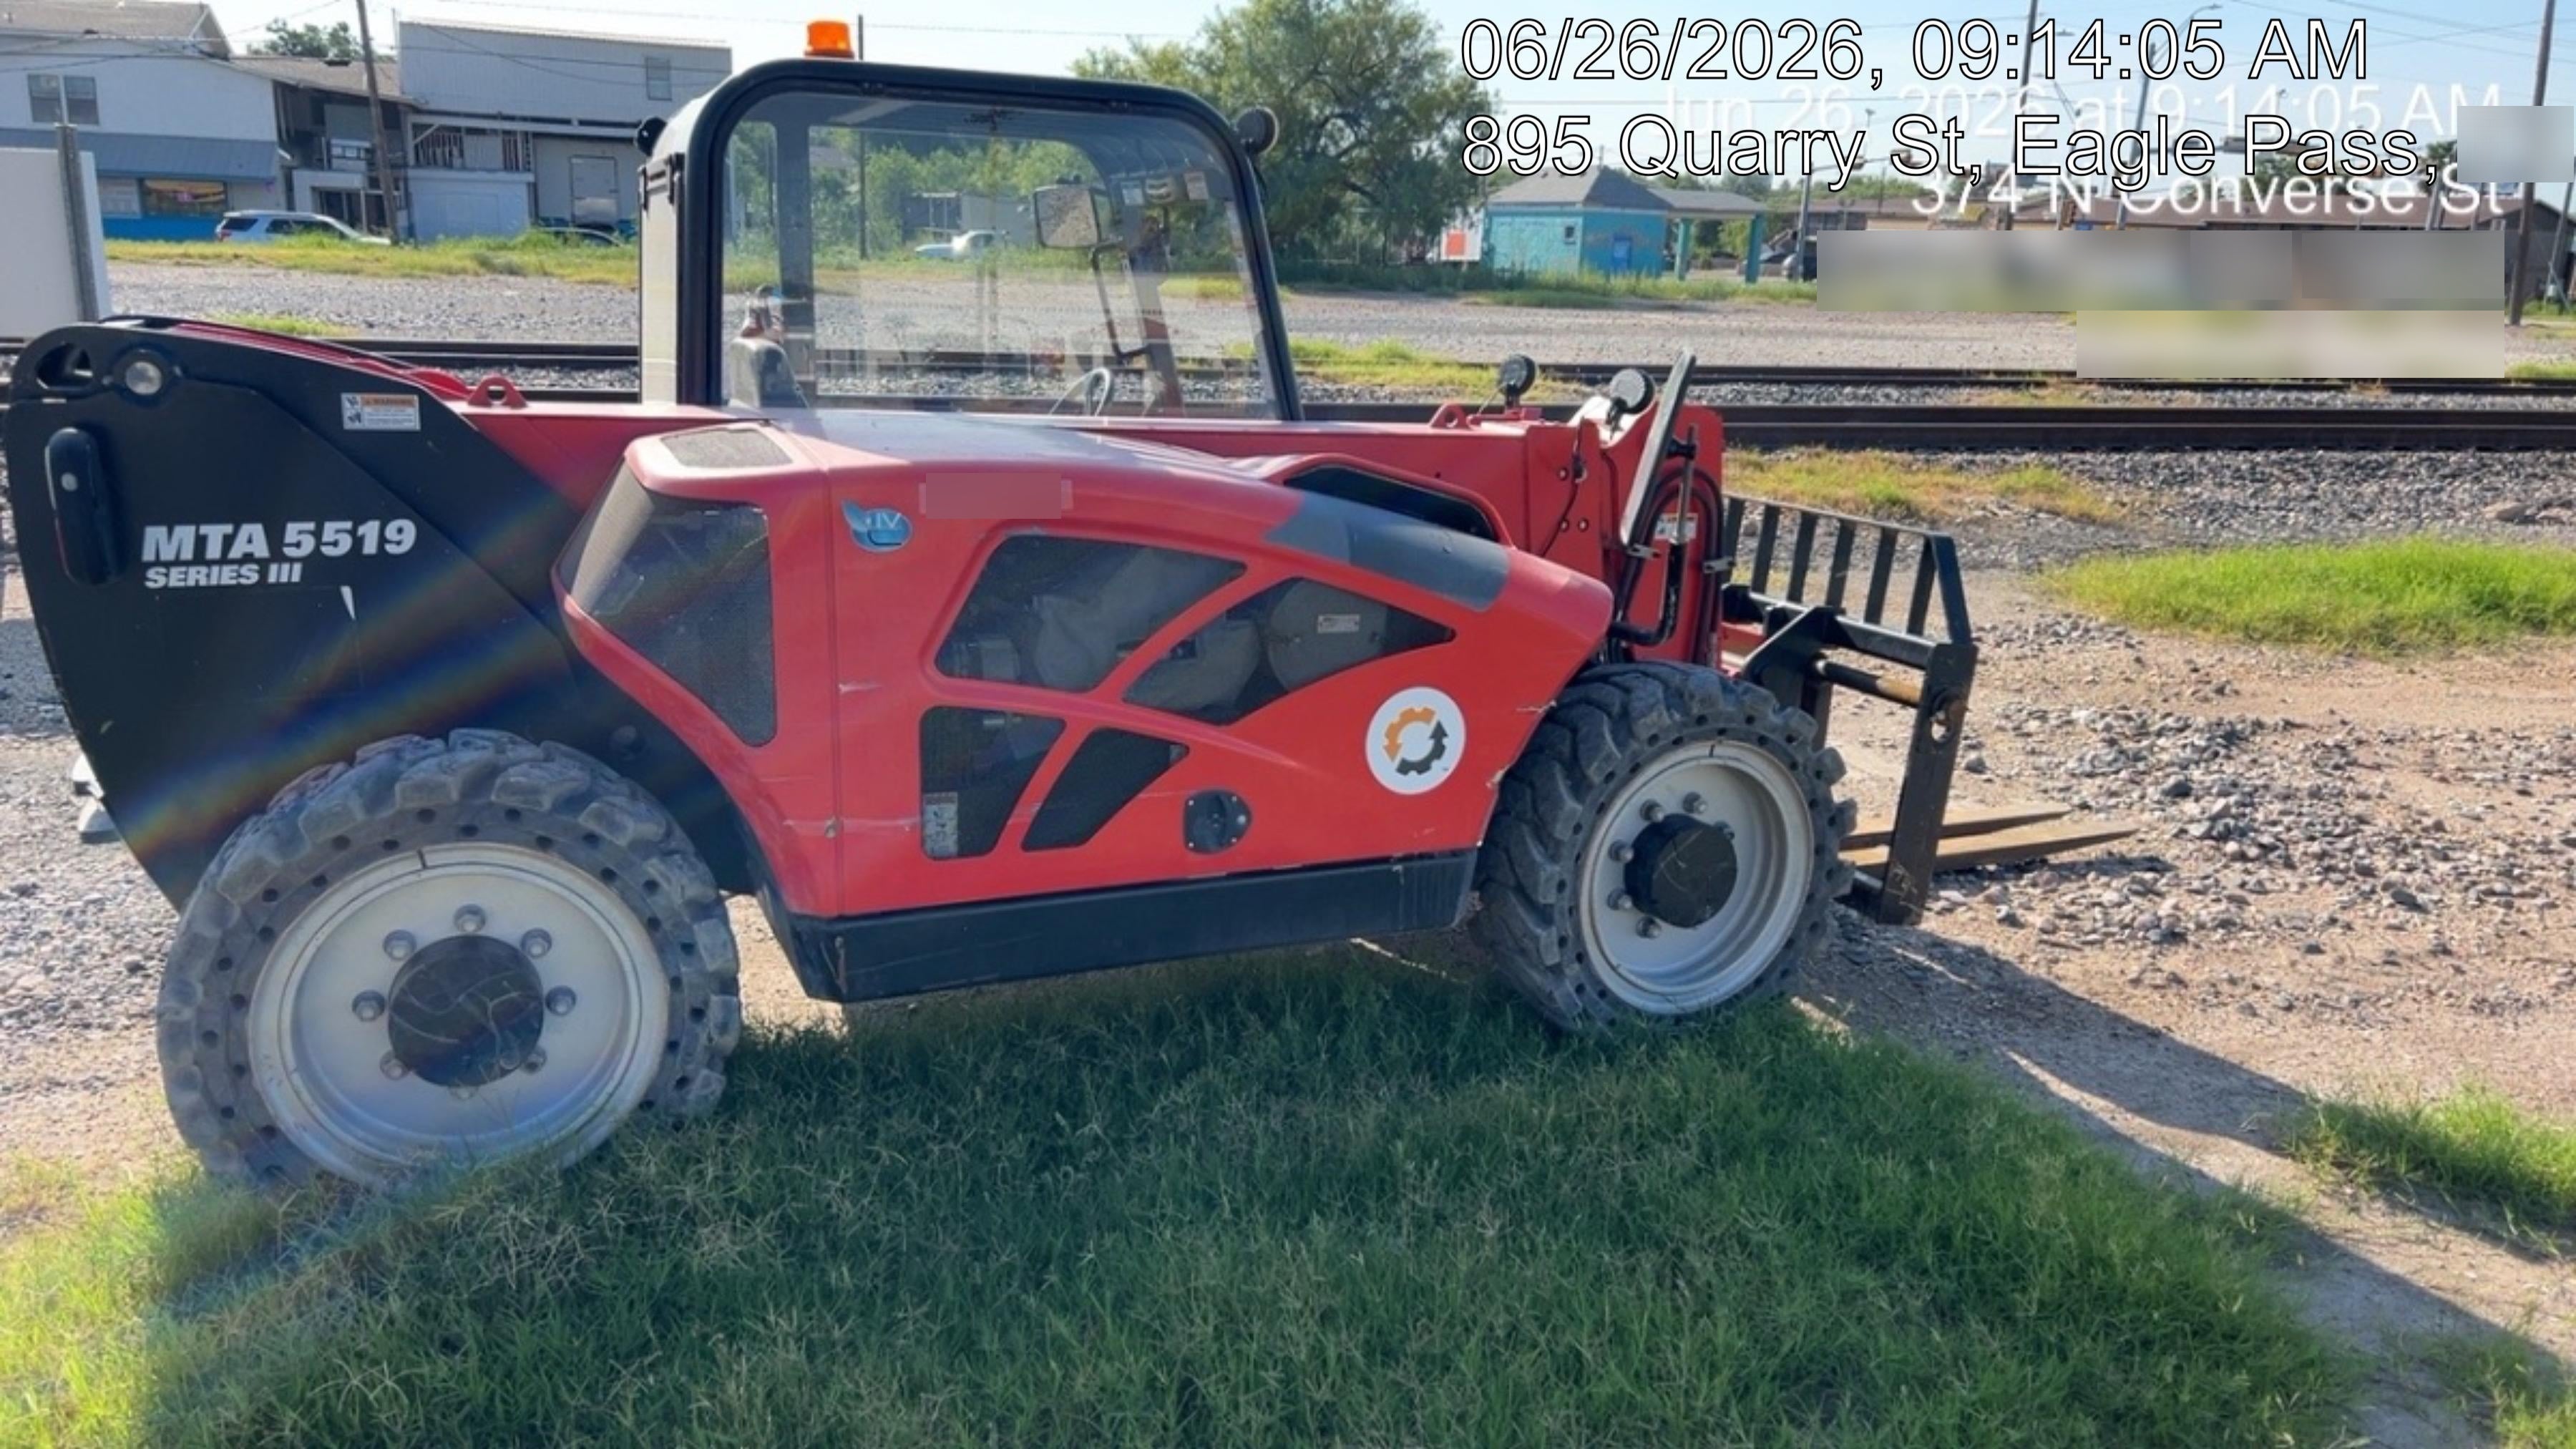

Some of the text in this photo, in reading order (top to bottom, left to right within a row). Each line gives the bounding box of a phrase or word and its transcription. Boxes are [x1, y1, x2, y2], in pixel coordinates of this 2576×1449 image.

[142, 518, 417, 562] MTA 5519
[145, 562, 303, 589] SERIES III
